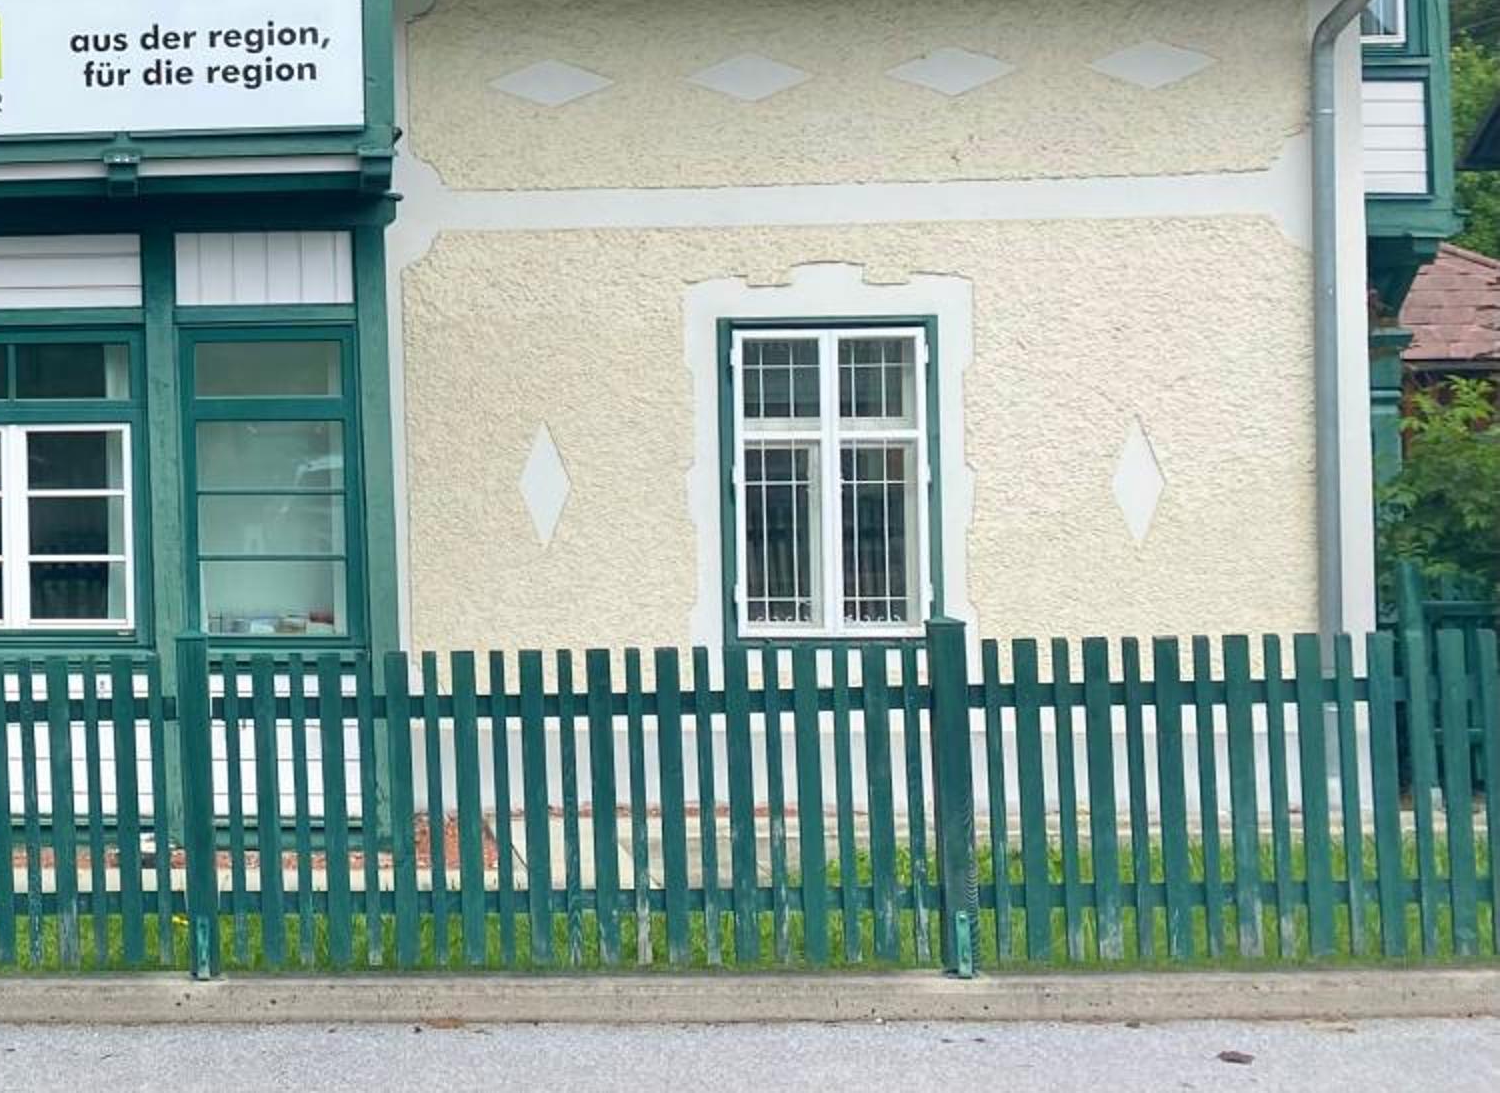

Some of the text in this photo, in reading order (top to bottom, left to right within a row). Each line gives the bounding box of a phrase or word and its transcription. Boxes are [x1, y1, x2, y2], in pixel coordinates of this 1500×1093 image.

[69, 20, 330, 54] aus der region,
[83, 55, 317, 90] für die region
